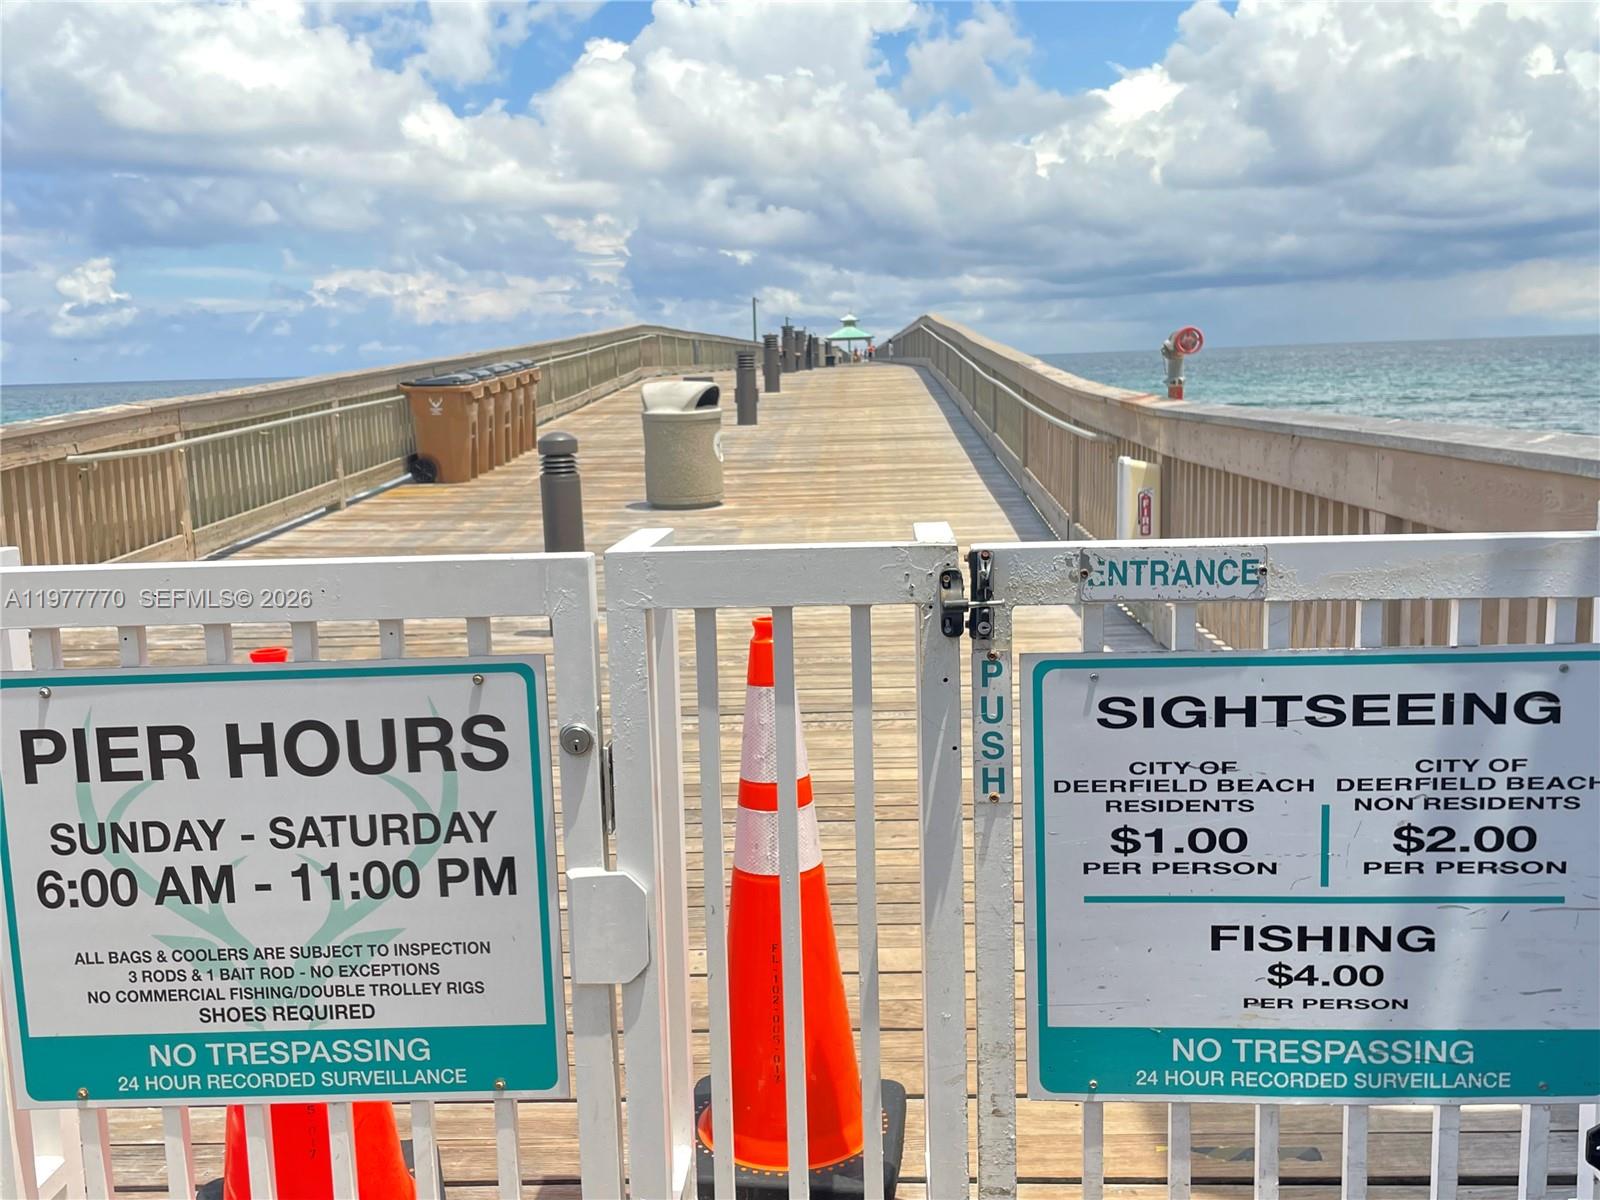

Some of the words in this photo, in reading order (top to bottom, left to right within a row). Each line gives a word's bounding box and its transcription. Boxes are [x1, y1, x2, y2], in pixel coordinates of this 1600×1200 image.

[1097, 691, 1561, 729] SIGHTSEEING
[981, 660, 1005, 794] PUSH
[20, 726, 200, 784] PIER
[226, 715, 509, 778] HOURS
[1129, 762, 1191, 775] CITY
[1199, 761, 1237, 774] OF
[1416, 759, 1479, 773] CITY
[1489, 759, 1527, 772] OF
[1054, 779, 1207, 793] DEERFIELD
[1218, 779, 1314, 792] BEACH
[1337, 777, 1496, 791] DEERFIELD
[1507, 776, 1600, 790] BEACH
[1106, 800, 1254, 812] RESIDENTS
[1355, 797, 1416, 811] NON
[1424, 796, 1580, 810] RESIDENTS
[51, 819, 225, 855] SUNDAY
[270, 811, 497, 849] SATURDAY
[1111, 825, 1247, 857] $1.00
[1393, 823, 1537, 856] $2.00
[1083, 862, 1141, 874] PER
[1153, 862, 1277, 874] PERSON
[1364, 862, 1424, 874] PER
[1436, 861, 1566, 874] PERSON
[37, 868, 138, 909] 6:00
[155, 865, 235, 905] AM
[291, 860, 420, 901] 11:00
[438, 856, 517, 897] PM
[1211, 925, 1435, 952] FISHING
[75, 952, 104, 965] ALL
[109, 951, 152, 964] BAGS
[157, 951, 167, 962] &
[172, 948, 248, 962] COOLERS
[253, 947, 285, 960] ARE
[290, 945, 362, 959] SUBJECT
[367, 944, 389, 956] TO
[394, 942, 490, 956] INSPECTION
[129, 971, 137, 983] 3
[142, 969, 187, 982] RODS
[192, 969, 202, 981] &
[207, 969, 213, 981] 1
[220, 968, 255, 980] BAIT
[260, 967, 294, 979] ROD
[311, 965, 333, 978] NO
[339, 963, 439, 977] EXCEPTIONS
[1267, 962, 1384, 988] $4.00
[88, 991, 110, 1003] NO
[116, 988, 225, 1003] COMMERCIAL
[230, 985, 365, 1000] FISHING/DOUBLE
[369, 982, 441, 996] TROLLEY
[447, 981, 484, 994] RIGS
[200, 1007, 266, 1023] SHOES
[273, 1004, 375, 1021] REQUIRED
[1244, 998, 1293, 1008] PER
[1303, 999, 1408, 1009] PERSON
[150, 1044, 196, 1066] NO
[206, 1038, 430, 1065] TRESPASSING
[1173, 1039, 1221, 1061] NO
[1232, 1040, 1473, 1063] TRESPASSING
[119, 1077, 138, 1090] 24
[146, 1075, 200, 1090] HOUR
[208, 1073, 315, 1088] RECORDED
[322, 1069, 466, 1086] SURVEILLANCE
[1137, 1071, 1157, 1085] 24
[1166, 1071, 1223, 1085] HOUR
[1232, 1072, 1347, 1088] RECORDED
[1355, 1073, 1508, 1088] SURVEILLANCE
